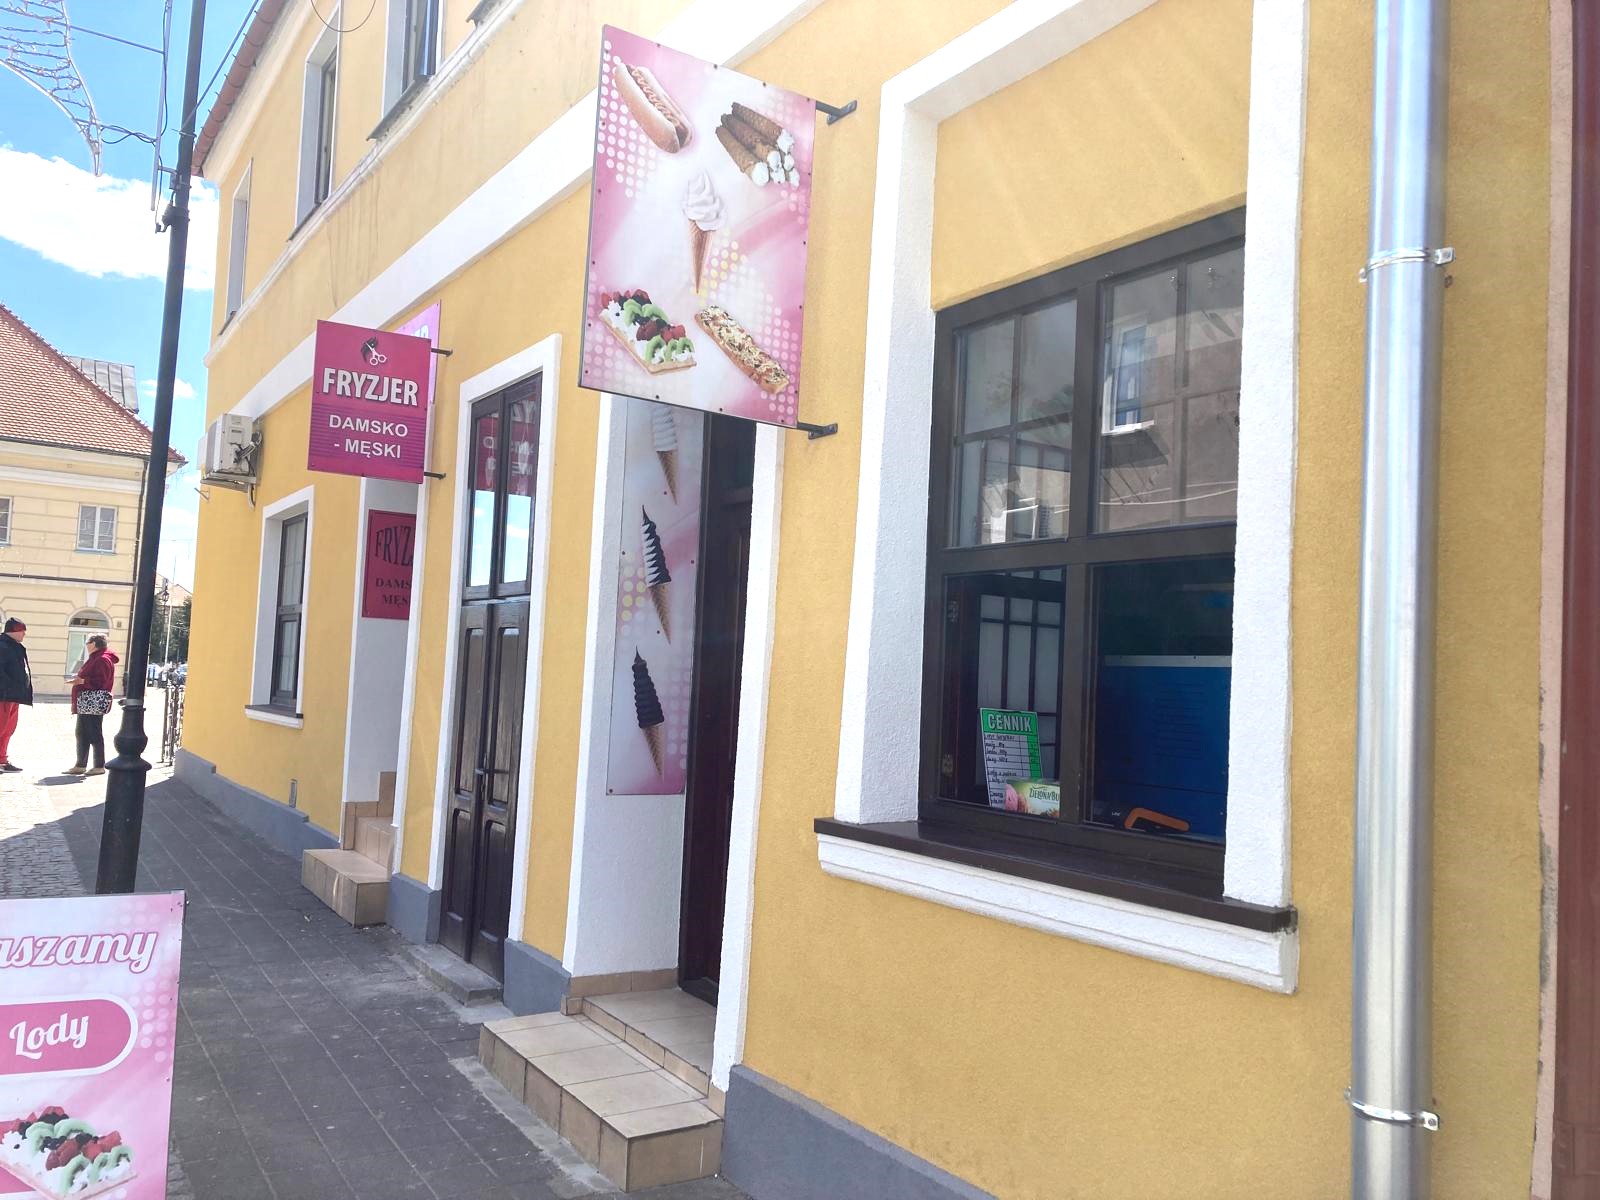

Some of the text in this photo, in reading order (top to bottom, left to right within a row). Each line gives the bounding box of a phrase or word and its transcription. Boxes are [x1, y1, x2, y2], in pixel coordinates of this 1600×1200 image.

[322, 367, 418, 406] FRYZJER
[328, 414, 408, 437] DAMSKO
[344, 438, 401, 459] MĘSKI
[375, 525, 415, 567] FRYZ
[988, 713, 1032, 732] CENNIK
[9, 1013, 90, 1060] Lody
